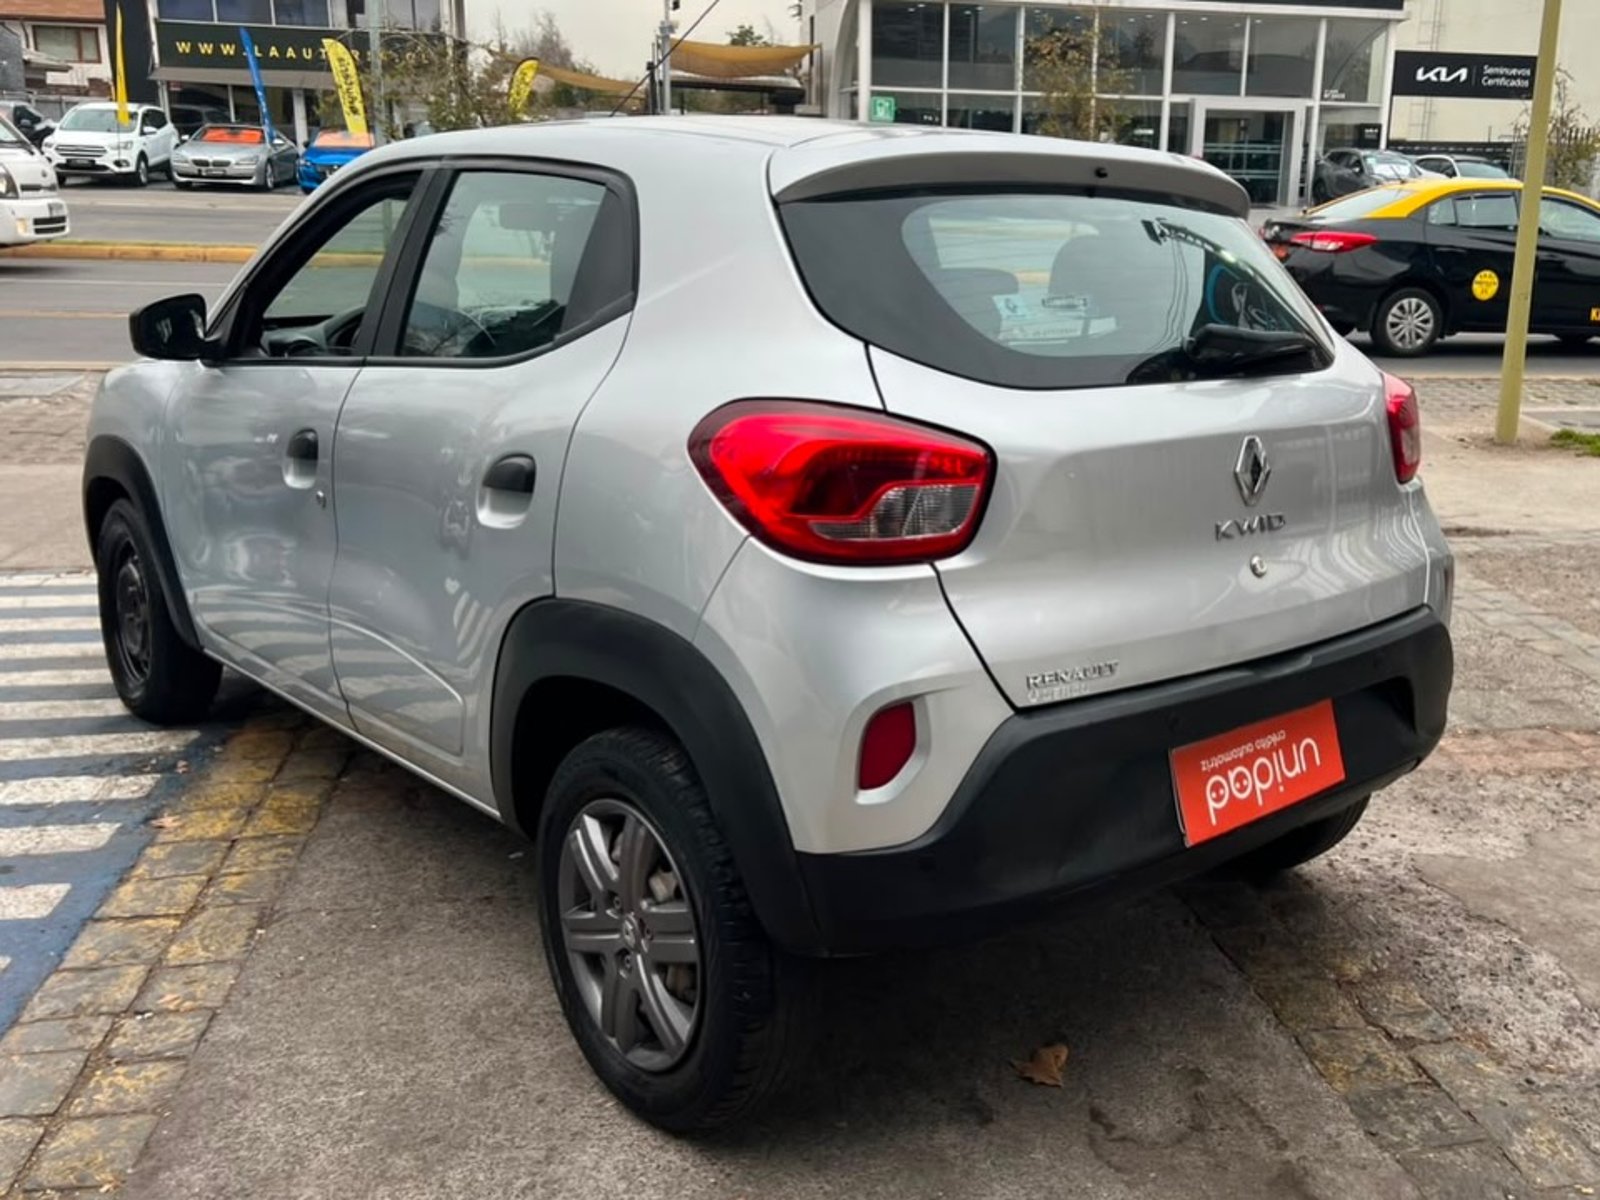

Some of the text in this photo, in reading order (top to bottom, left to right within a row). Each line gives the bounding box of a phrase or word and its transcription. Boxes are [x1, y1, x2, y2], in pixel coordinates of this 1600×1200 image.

[1482, 76, 1529, 88] Certificados
[1483, 65, 1531, 76] Seminuevos
[1215, 513, 1286, 541] KWID
[1026, 660, 1119, 690] RENAULT
[1200, 743, 1254, 772] automotriz
[1206, 738, 1321, 826] unidad
